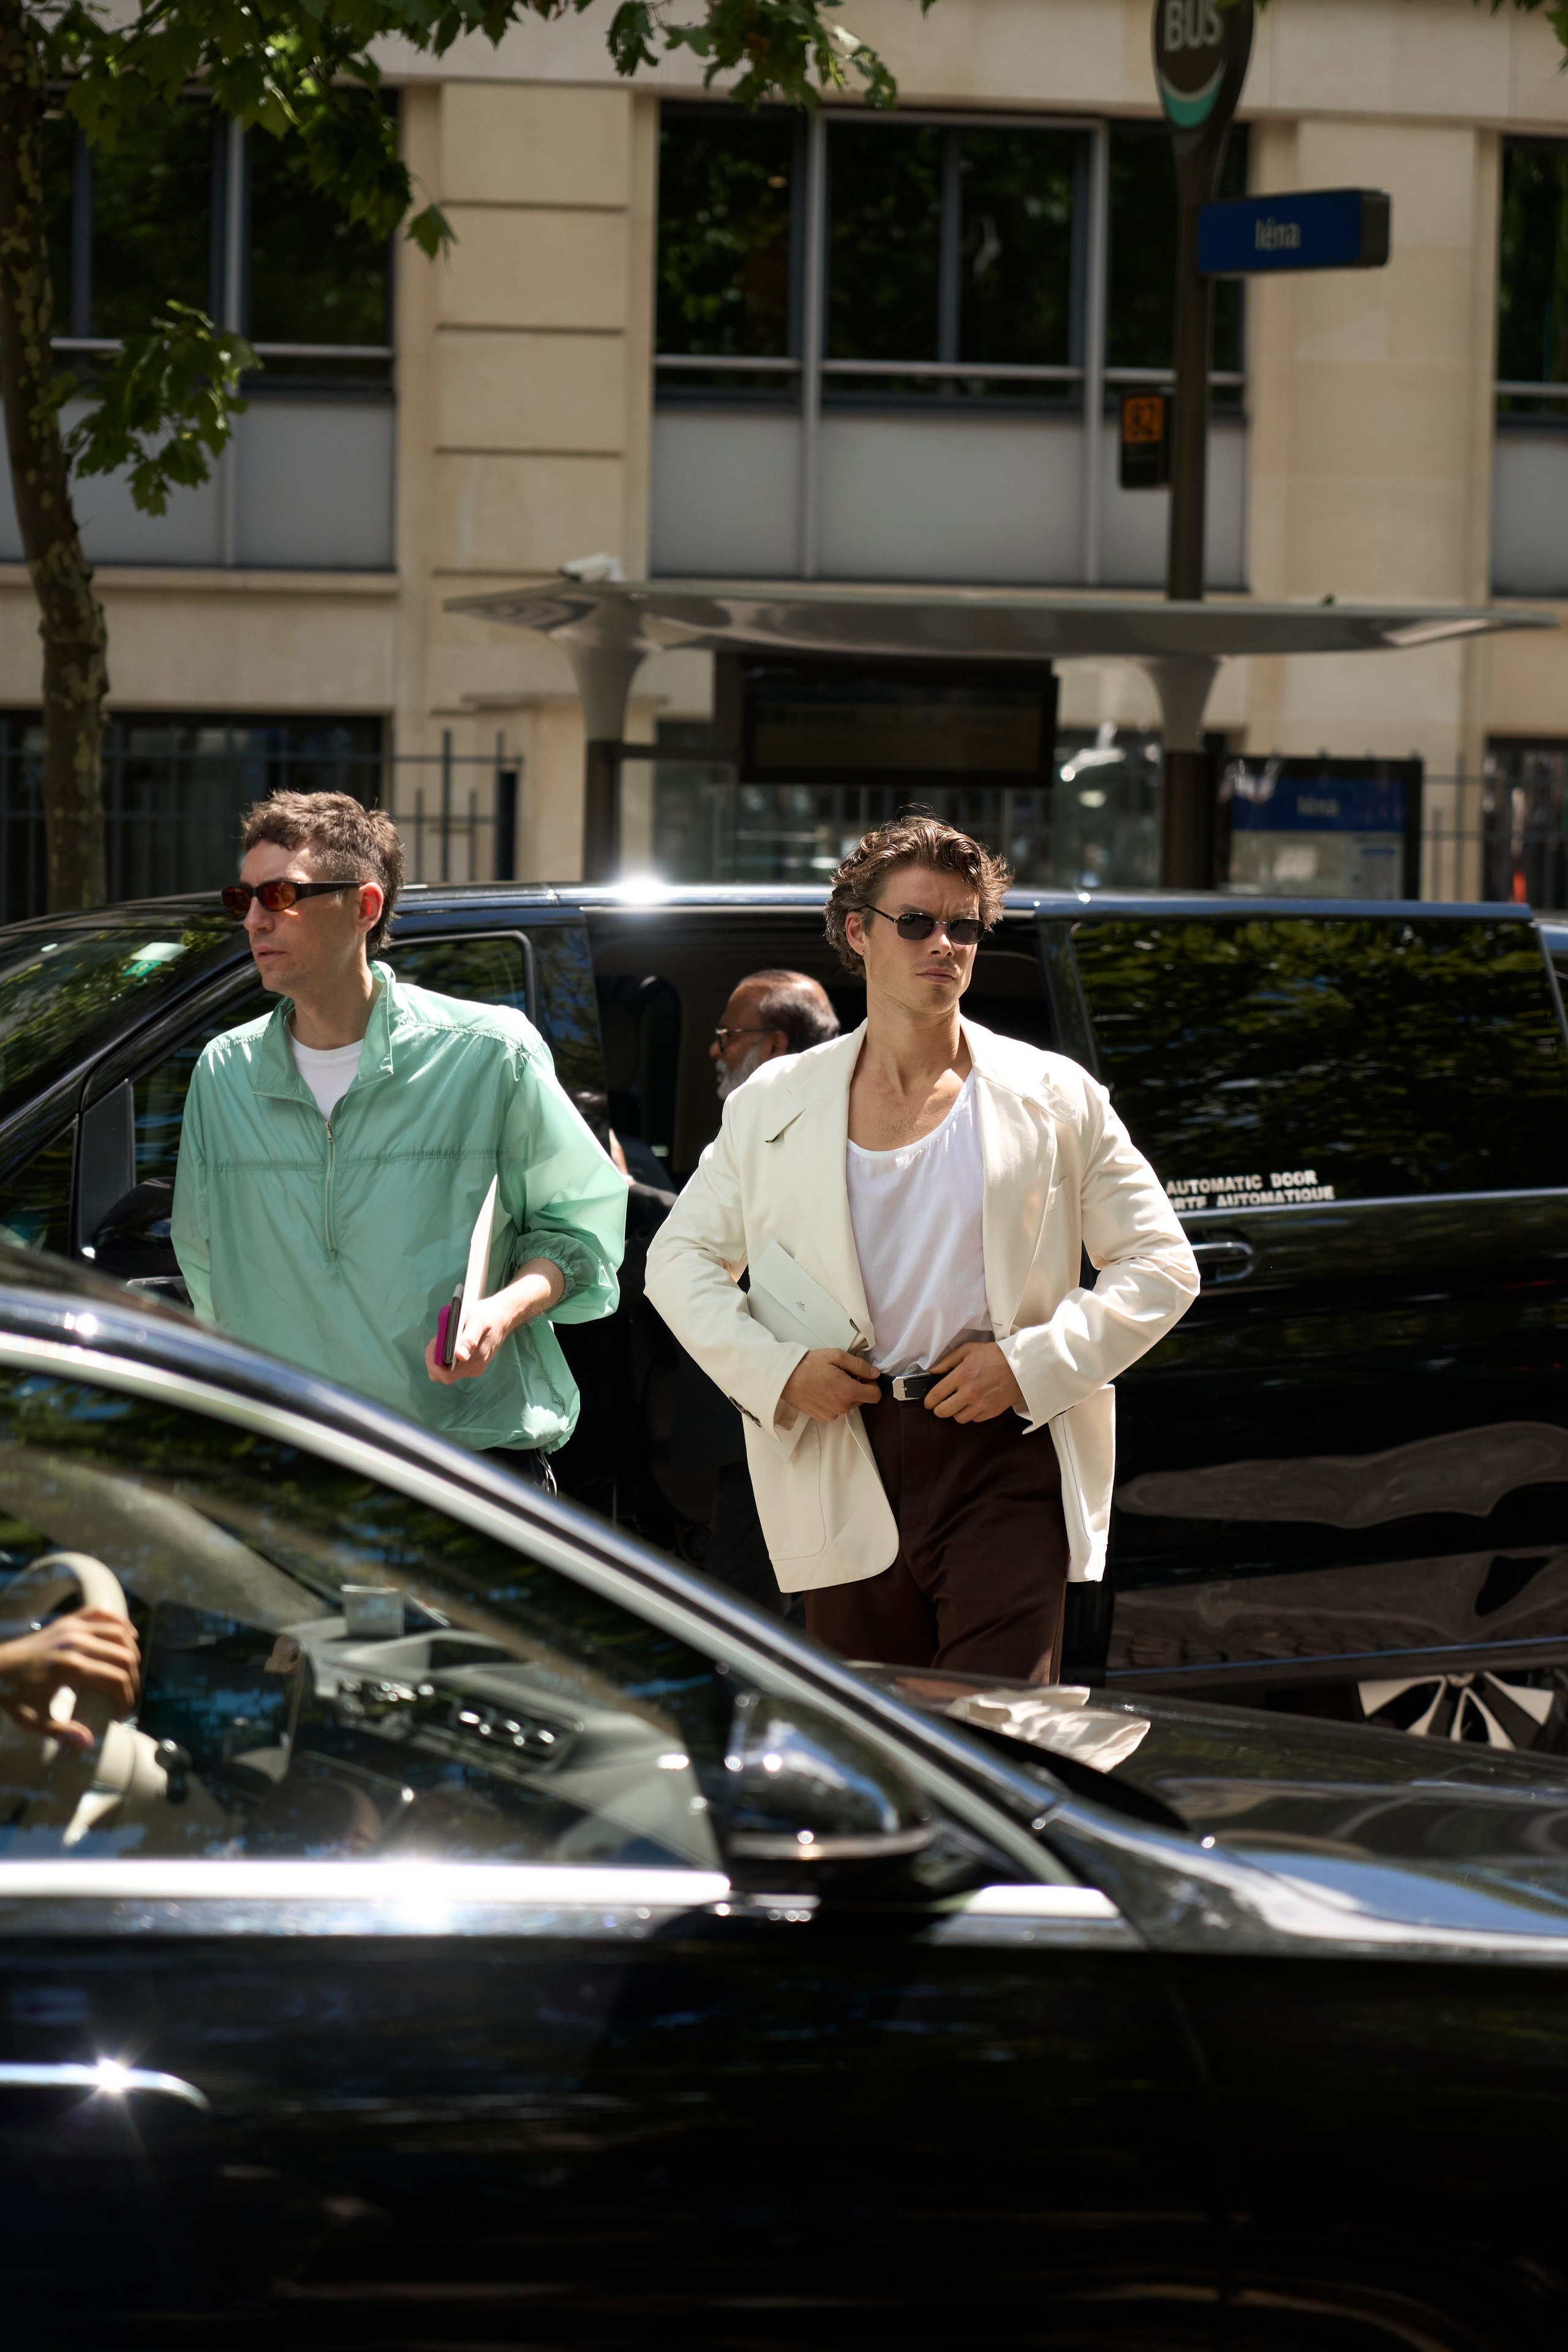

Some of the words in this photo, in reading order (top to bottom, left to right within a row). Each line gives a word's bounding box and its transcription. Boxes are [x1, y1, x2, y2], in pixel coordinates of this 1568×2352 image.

[1164, 0, 1224, 53] BUS
[1255, 216, 1302, 251] Iéna
[1166, 1174, 1264, 1196] AUTOMATIC
[1269, 1169, 1318, 1189] DOOR
[1216, 1185, 1335, 1208] AUTOMATIQUE
